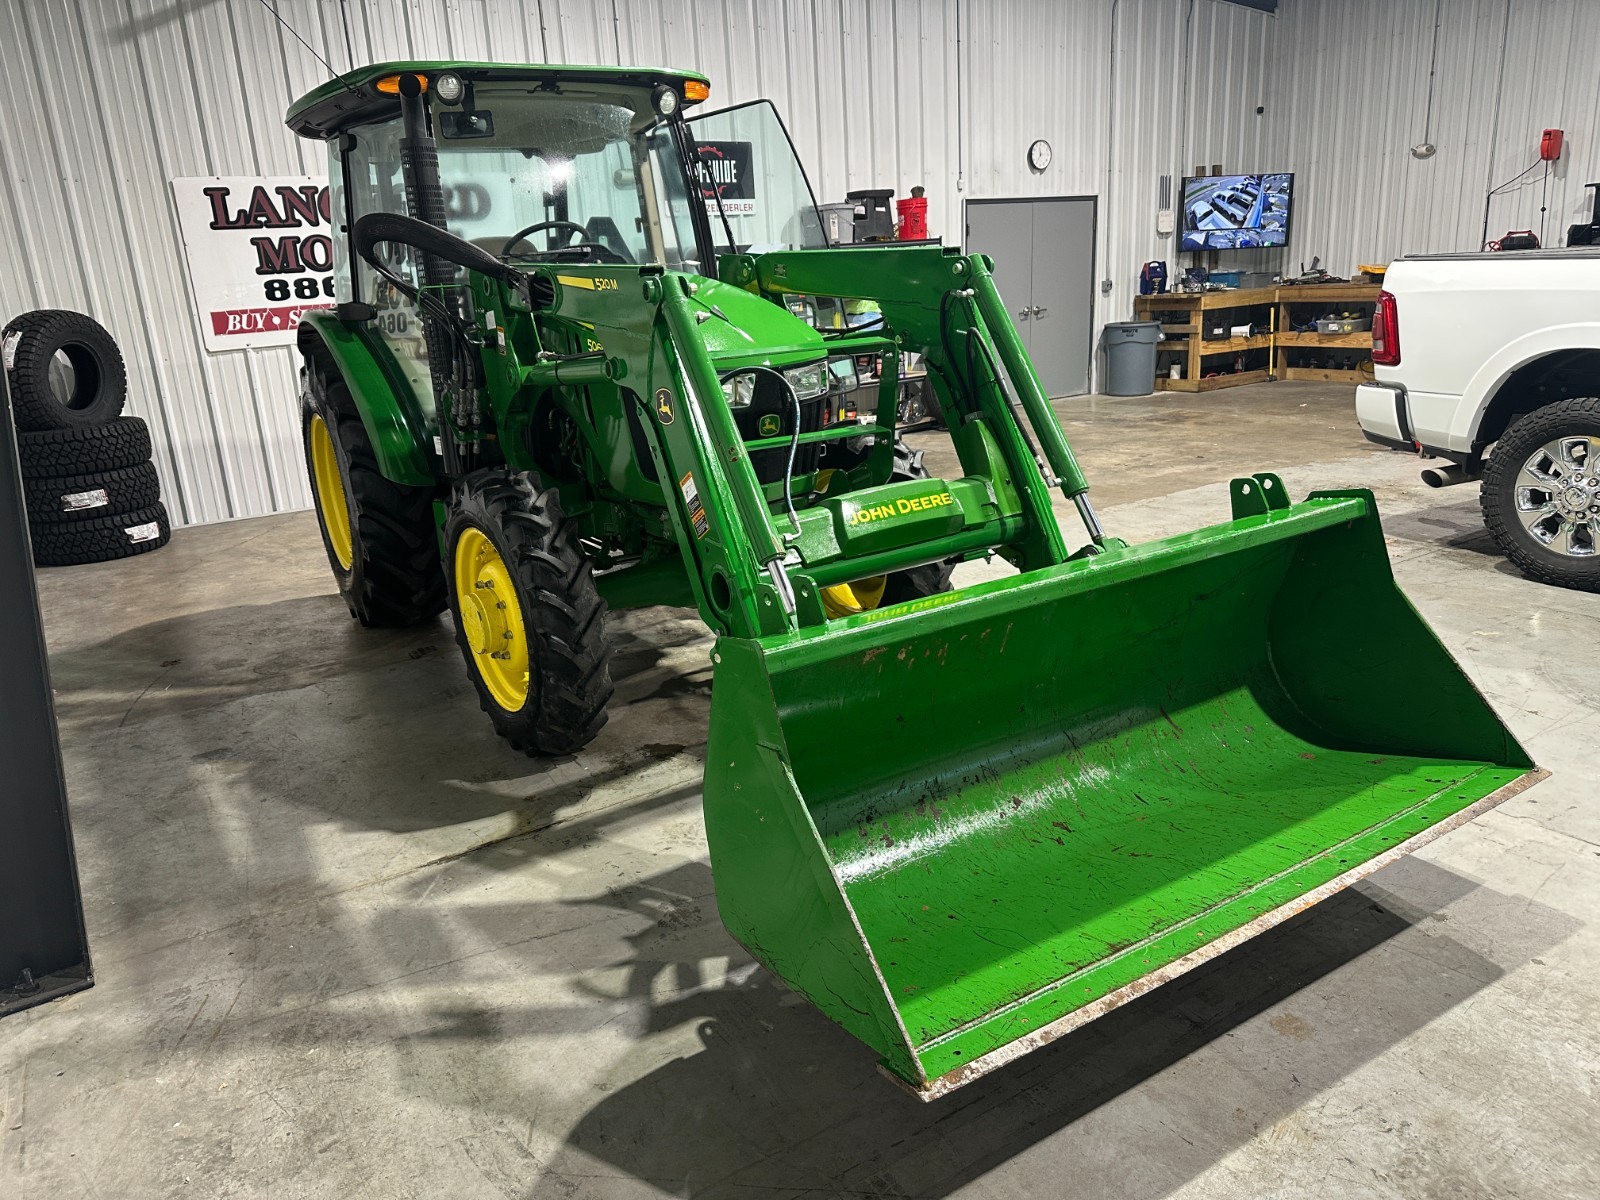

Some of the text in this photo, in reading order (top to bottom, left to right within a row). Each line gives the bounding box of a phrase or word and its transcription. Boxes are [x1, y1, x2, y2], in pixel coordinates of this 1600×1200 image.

[227, 311, 267, 331] BUY
[851, 492, 953, 525] JOHN DEERE
